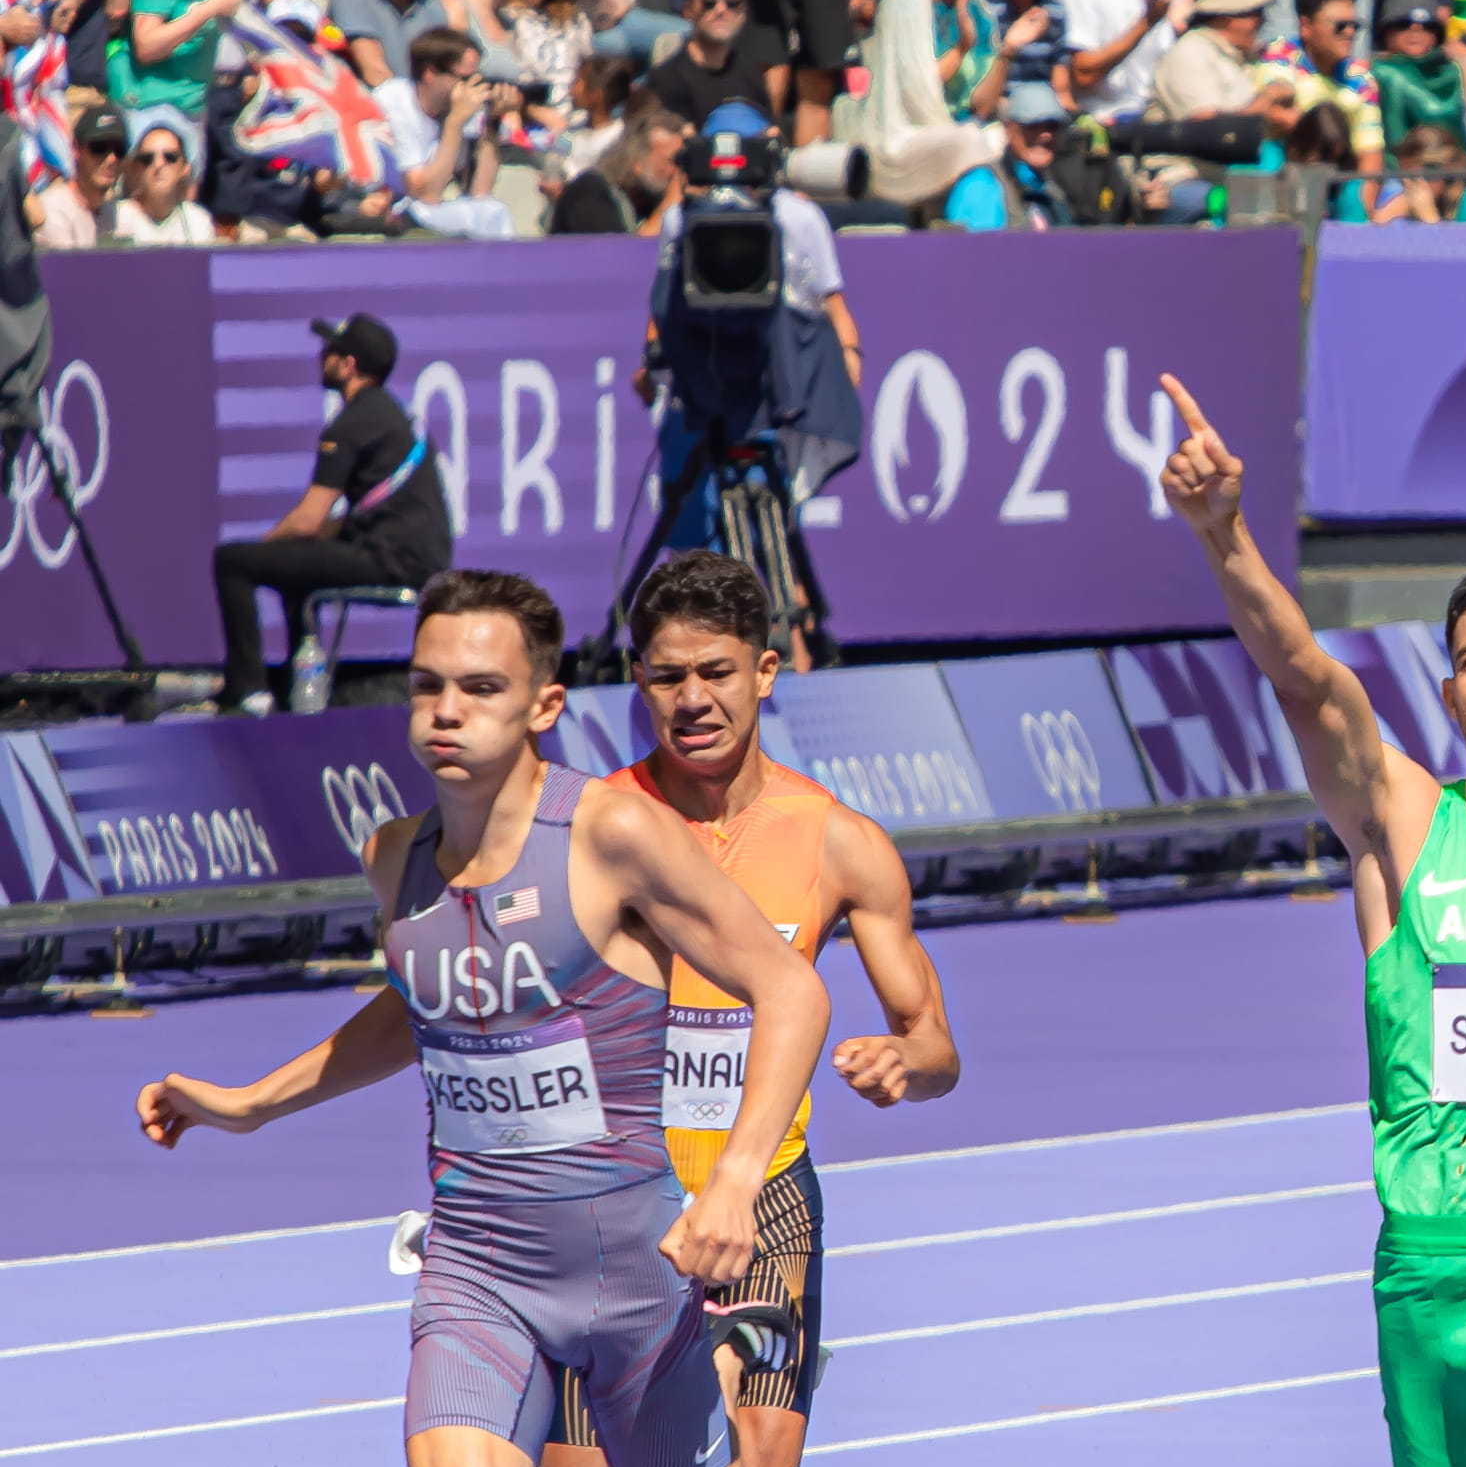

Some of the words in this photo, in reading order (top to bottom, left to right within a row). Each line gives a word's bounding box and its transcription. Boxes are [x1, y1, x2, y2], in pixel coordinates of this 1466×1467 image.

[191, 807, 279, 880] 2024
[404, 940, 563, 1021] USA
[667, 1008, 712, 1024] PARIS
[490, 1035, 534, 1049] 2024
[427, 1065, 589, 1114] KESSLER
